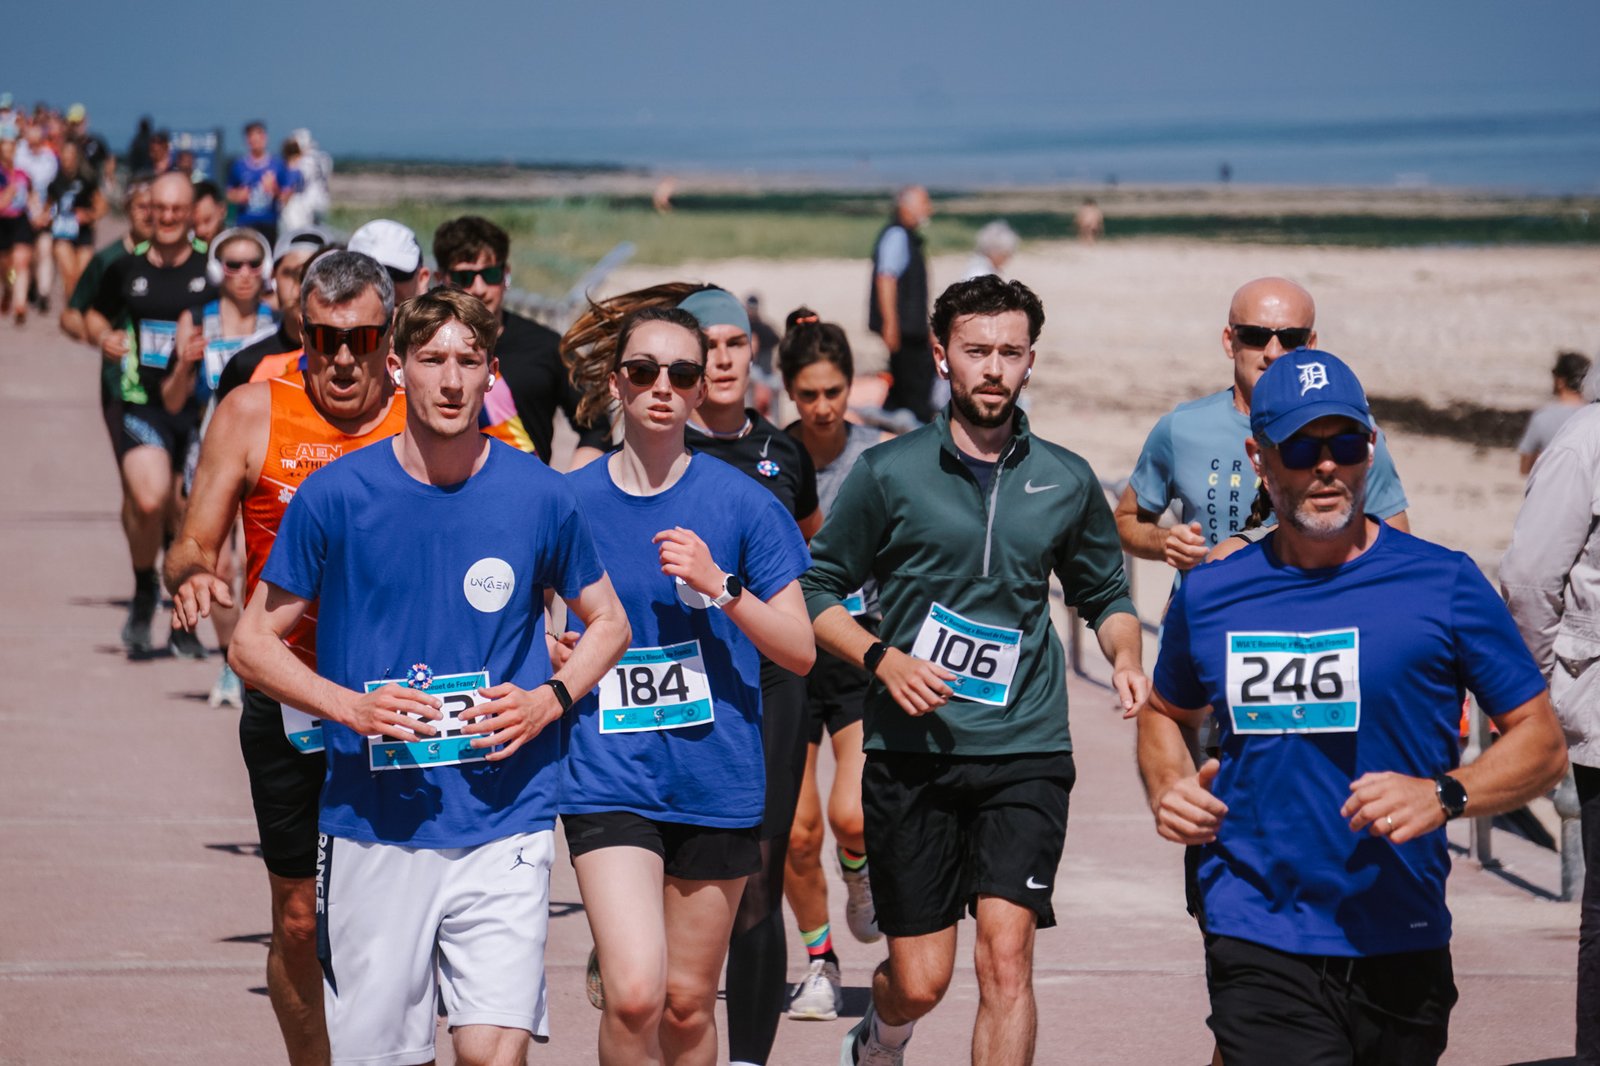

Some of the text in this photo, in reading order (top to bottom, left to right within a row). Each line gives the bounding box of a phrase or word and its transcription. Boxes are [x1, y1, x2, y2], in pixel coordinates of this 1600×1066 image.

[1296, 361, 1330, 397] D
[930, 627, 1001, 679] 106
[1258, 640, 1288, 650] Running
[1325, 638, 1349, 648] France
[616, 663, 690, 707] 184
[1241, 653, 1343, 704] 246
